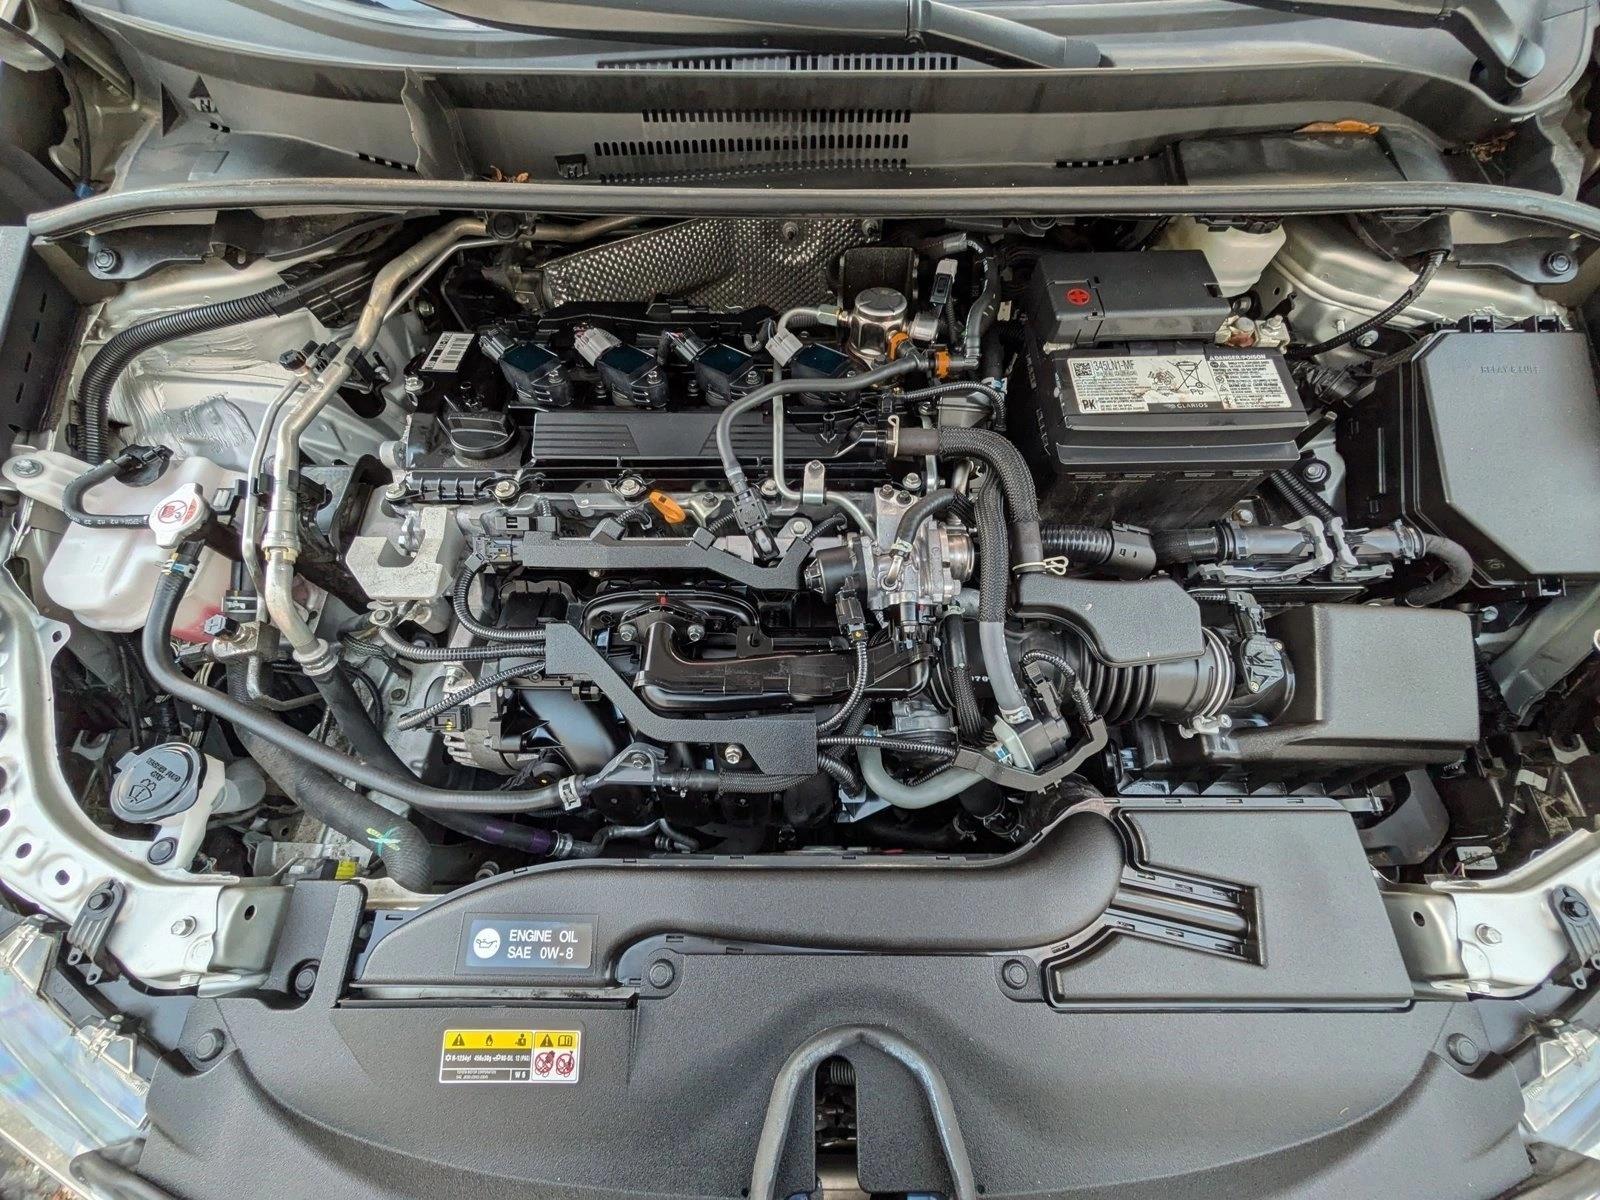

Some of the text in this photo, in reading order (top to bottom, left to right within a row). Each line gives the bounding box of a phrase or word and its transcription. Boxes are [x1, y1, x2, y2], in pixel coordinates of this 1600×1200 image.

[1082, 399, 1097, 410] PK
[1177, 401, 1208, 409] CLARIOS
[509, 929, 578, 943] ENGINE OIL
[507, 946, 574, 960] SAE 0W-8
